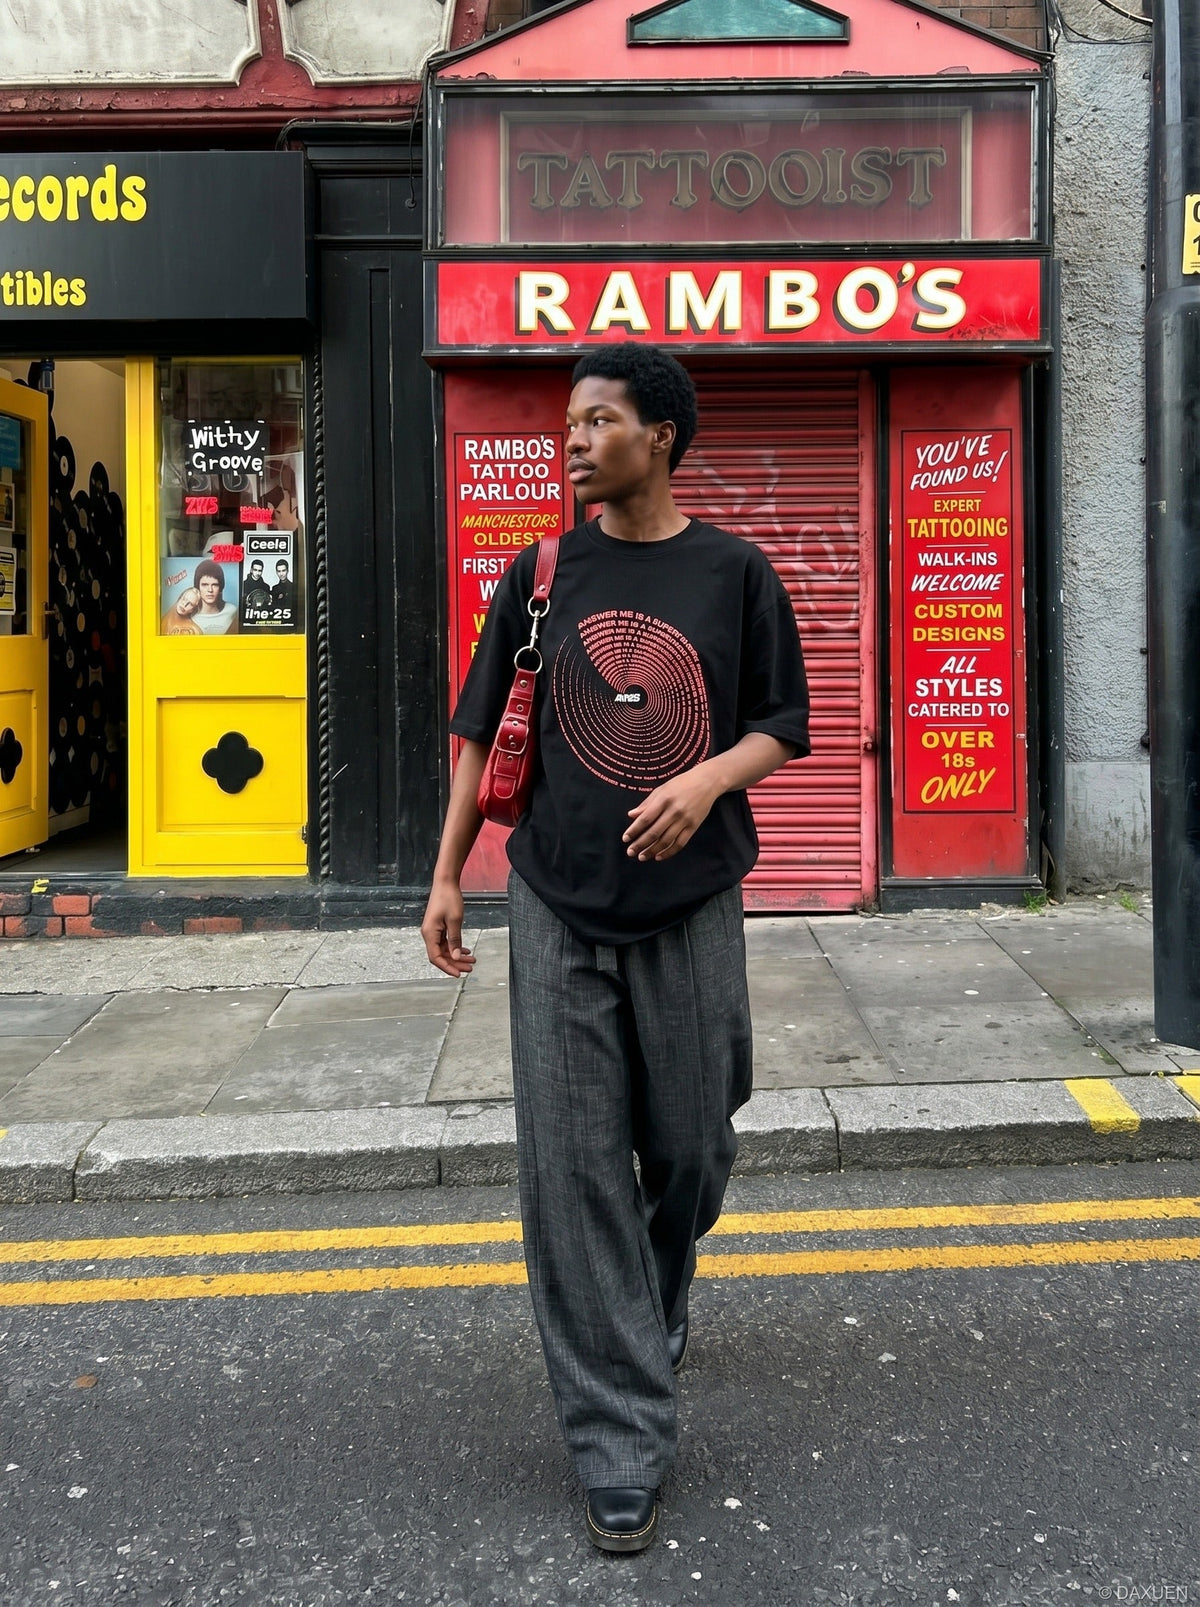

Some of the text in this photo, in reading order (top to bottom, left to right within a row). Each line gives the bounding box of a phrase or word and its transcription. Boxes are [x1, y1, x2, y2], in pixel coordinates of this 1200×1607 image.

[517, 147, 947, 210] TATTOOIST
[516, 262, 967, 335] RAMBO'S
[464, 435, 556, 460] RAMBO'S
[916, 434, 993, 469] YOU'VE
[192, 452, 263, 472] Groove
[469, 463, 550, 479] TATTOO
[910, 450, 1008, 491] FOUND US!
[460, 483, 561, 501] PARLOUR
[934, 499, 982, 512] EXPERT
[461, 514, 560, 528] MANCHESTORS
[907, 517, 1008, 538] TATTOOING
[463, 558, 507, 574] FIRST
[918, 552, 998, 567] WALK-INS
[911, 573, 1004, 592] WELCOME
[914, 604, 1003, 619] CUSTOM
[913, 627, 1005, 642] DESIGNS
[940, 656, 977, 674] ALL
[915, 678, 1003, 697] STYLES
[908, 702, 1010, 717] CATERED TO
[921, 731, 995, 749] OVER
[941, 753, 976, 768] 18s
[920, 767, 996, 804] ONLY
